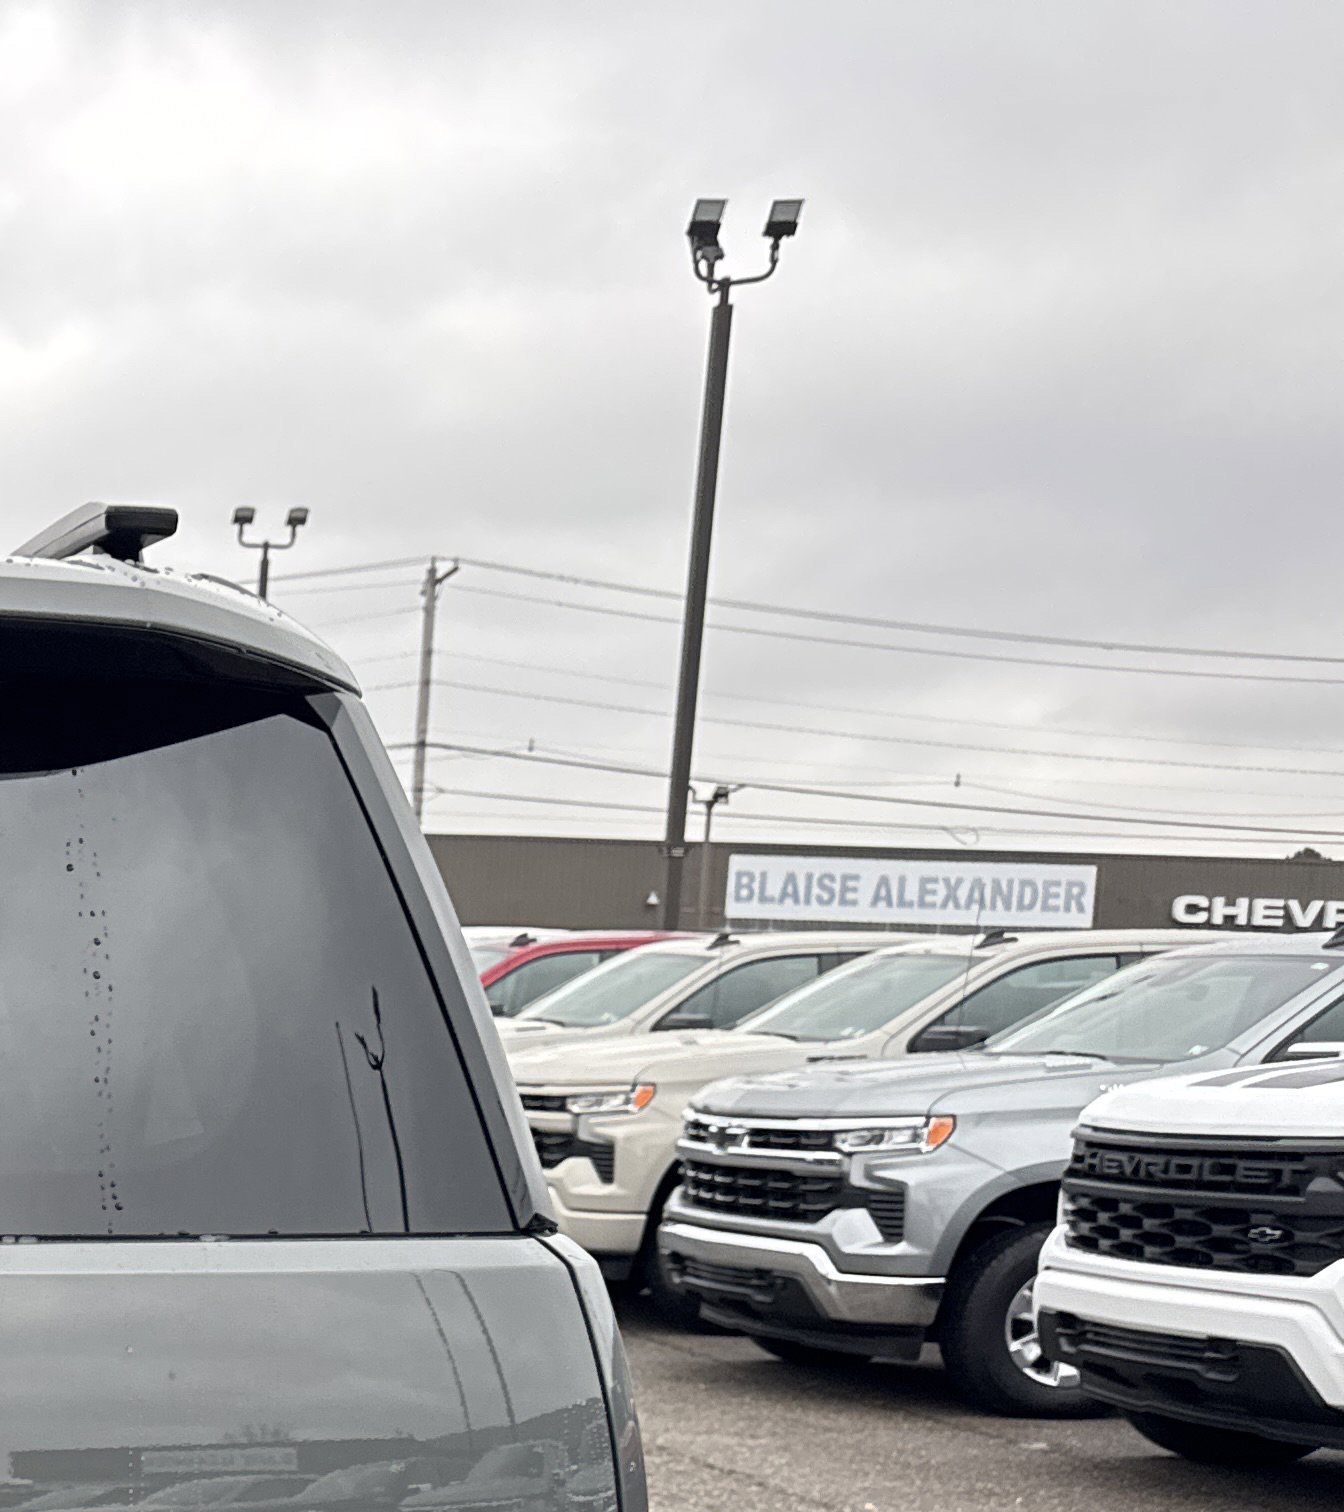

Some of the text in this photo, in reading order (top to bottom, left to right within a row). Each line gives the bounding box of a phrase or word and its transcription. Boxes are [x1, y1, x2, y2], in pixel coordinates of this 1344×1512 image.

[733, 869, 1087, 915] BLAISE ALEXANDER
[1069, 1149, 1309, 1186] CHEVROLET
